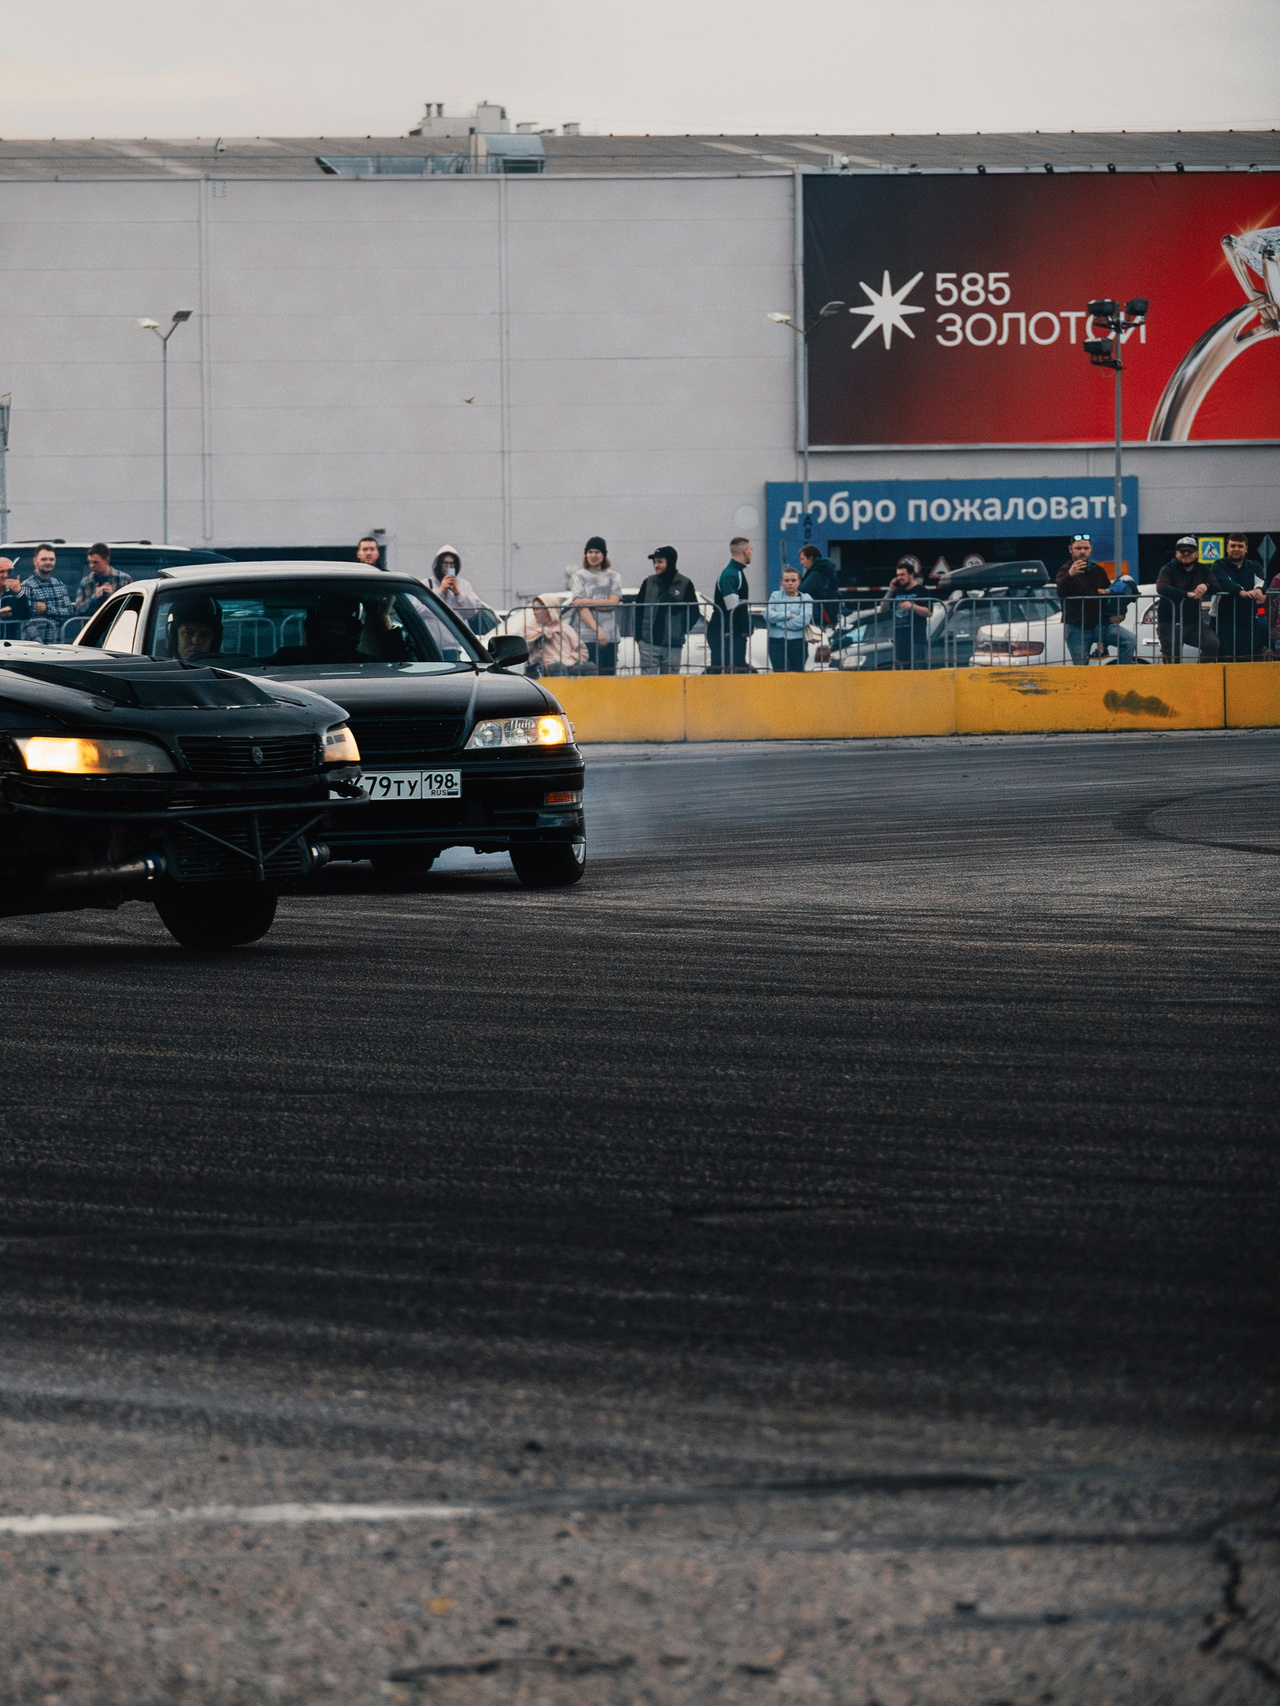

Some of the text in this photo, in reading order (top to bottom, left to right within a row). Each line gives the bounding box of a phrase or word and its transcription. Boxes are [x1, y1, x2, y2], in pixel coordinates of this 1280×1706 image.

[935, 272, 1011, 306] 585
[780, 491, 1128, 531] добро пожаловать
[424, 773, 454, 789] 198
